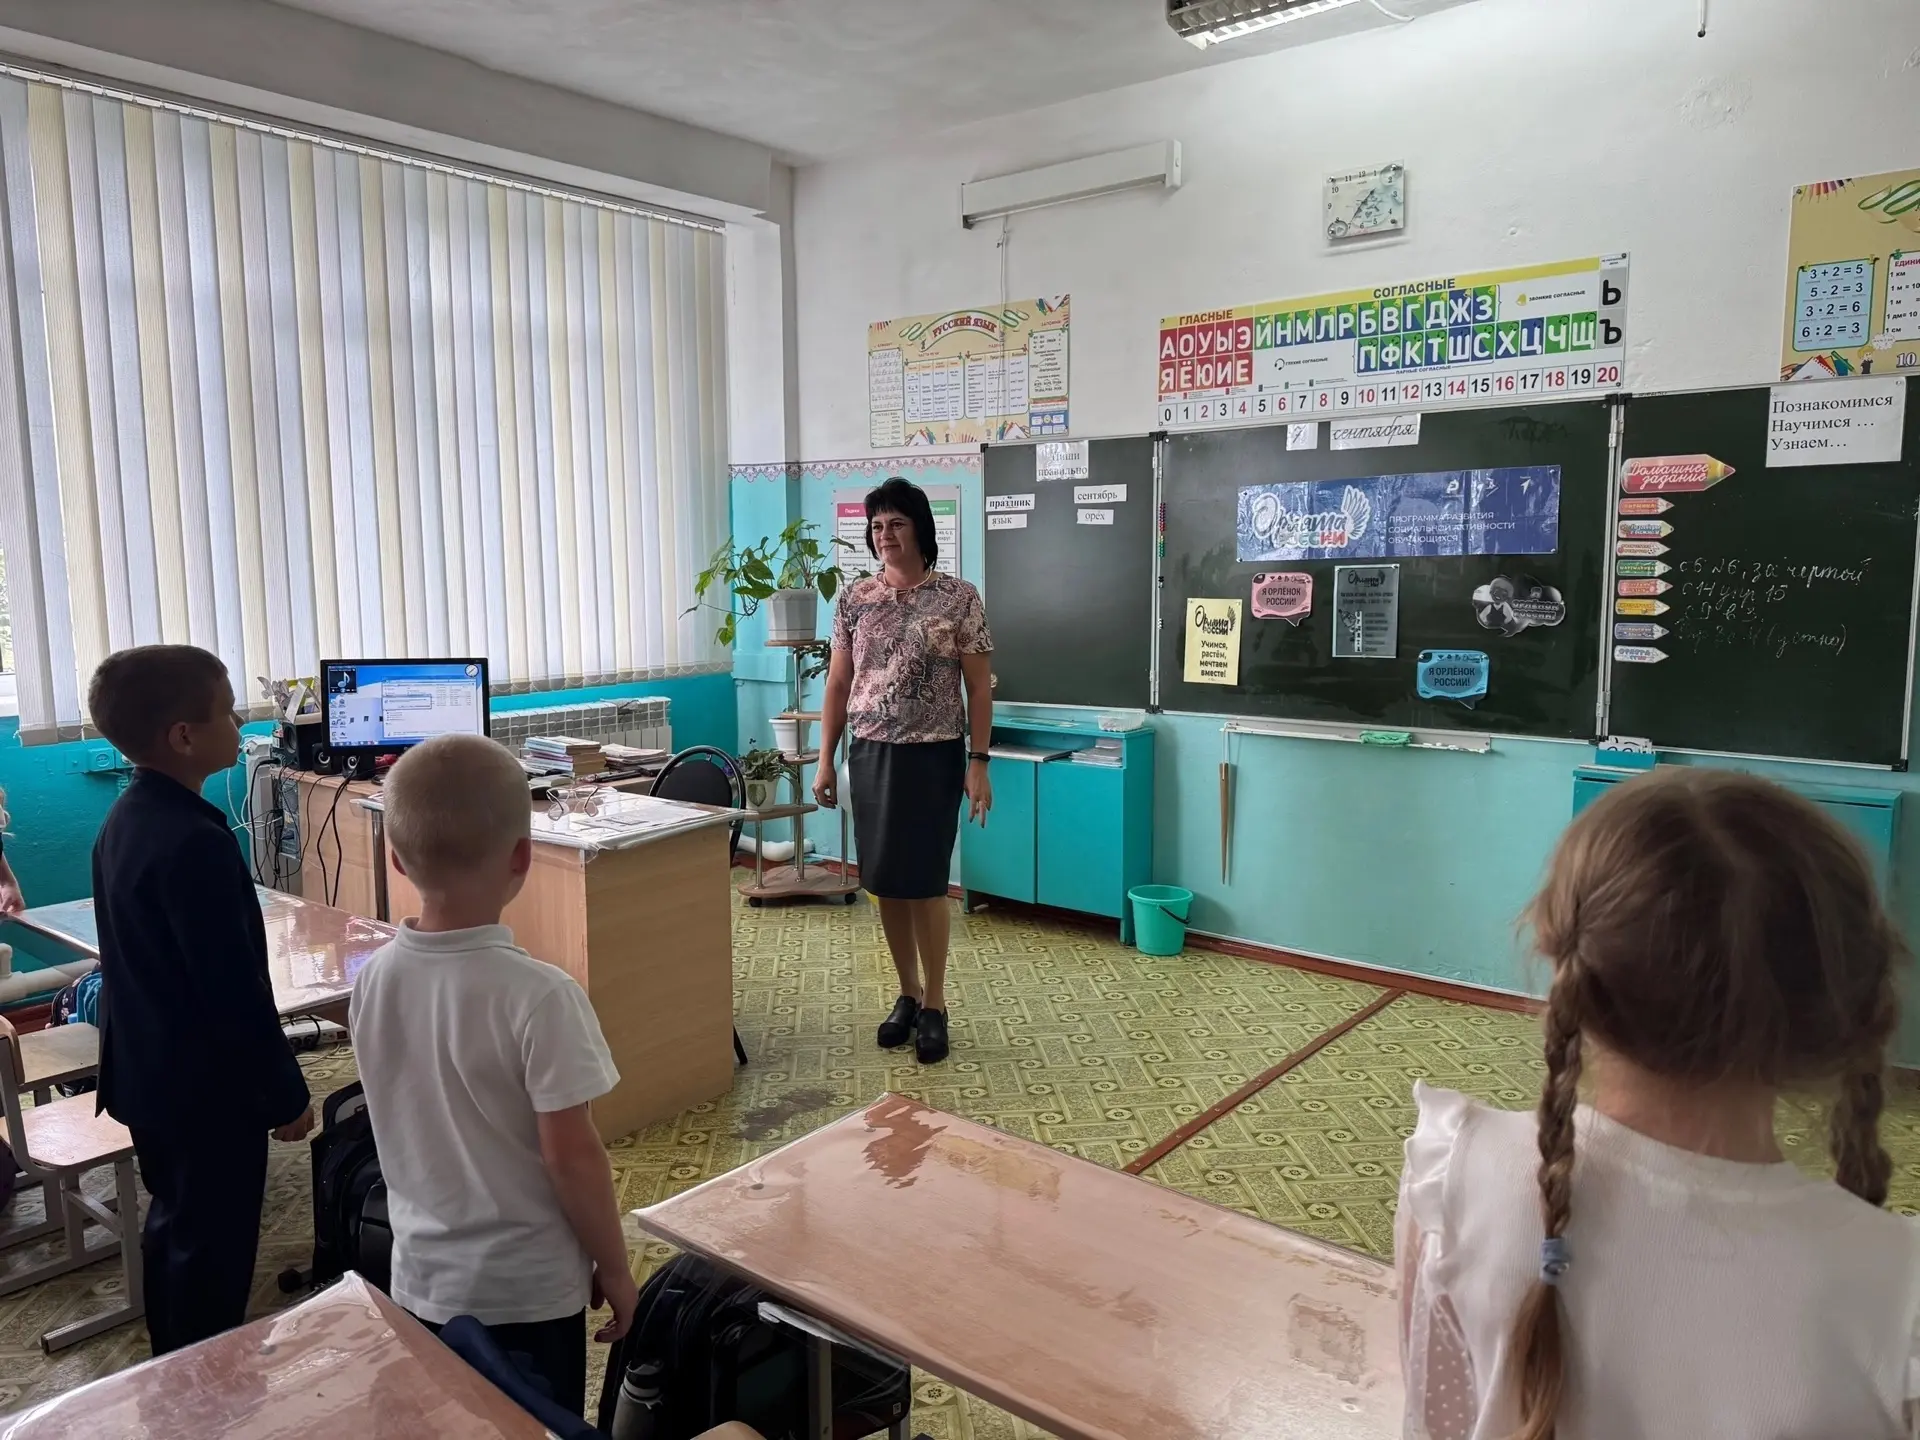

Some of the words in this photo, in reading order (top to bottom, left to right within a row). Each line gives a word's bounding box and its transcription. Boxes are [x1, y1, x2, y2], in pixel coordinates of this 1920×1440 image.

[1810, 269, 1817, 279] 3
[1832, 266, 1840, 277] 2
[1855, 263, 1863, 274] 5
[1373, 278, 1456, 299] СОГЛАСНЫЕ
[1553, 290, 1586, 298] СОГЛАСНЫЕ
[1810, 287, 1818, 297] 5
[1830, 285, 1838, 295] 2
[1855, 282, 1863, 293] 3
[1806, 306, 1813, 317] 3
[1826, 303, 1835, 315] 2
[1852, 301, 1860, 312] 6
[1179, 309, 1233, 326] ГЛАСНЫЕ
[932, 315, 972, 338] РУССКИЙ
[972, 317, 997, 333] ЯЗЫК
[1802, 326, 1810, 337] 6
[1824, 324, 1832, 336] 2
[1851, 322, 1860, 333] 3
[1164, 408, 1172, 422] 0
[1183, 407, 1189, 420] 1
[1200, 405, 1208, 419] 2
[1219, 403, 1227, 416] 3
[1239, 401, 1247, 414] 4
[1258, 399, 1266, 413] 5
[1278, 397, 1286, 411] 6
[1299, 395, 1307, 409] 7
[1319, 393, 1327, 407] 8
[1340, 391, 1349, 405] 9
[1357, 389, 1375, 404] 10
[1381, 386, 1396, 401] 11
[1402, 384, 1420, 400] 12
[1424, 382, 1442, 397] 13
[1447, 380, 1466, 396] 14
[1471, 378, 1490, 393] 15
[1495, 376, 1514, 391] 16
[1520, 374, 1539, 390] 17
[1545, 371, 1565, 387] 18
[1571, 368, 1591, 385] 19
[1597, 366, 1619, 383] 20
[1773, 396, 1893, 414] Познакомимся
[1333, 416, 1414, 444] сентября
[1771, 418, 1851, 434] Научимся
[1771, 438, 1847, 451] Узнаем...
[1038, 467, 1088, 477] правильно
[1628, 461, 1709, 476] Домашнее
[1640, 473, 1708, 490] задание
[1077, 490, 1118, 502] сентябрь
[989, 499, 1031, 509] праздник
[992, 517, 1012, 525] язык
[1085, 511, 1105, 521] орех
[1389, 513, 1443, 524] ПРОГРАММА
[1444, 512, 1494, 521] РАЗВИТИЯ
[1388, 524, 1450, 534] СОЦИАЛЬНОЙ
[1453, 522, 1515, 532] АКТИВНОСТИ
[1388, 535, 1458, 544] ОБУЧАЮЩИХСЯ
[1268, 586, 1301, 596] ОРЛЁНОК
[1266, 597, 1296, 606] РОССИИ!
[1201, 640, 1228, 650] Учимся,
[1201, 650, 1227, 660] растём,
[1200, 660, 1228, 669] мечтаем
[1201, 669, 1226, 678] вместе!
[1428, 667, 1434, 676] Я
[1436, 666, 1475, 676] ОРЛЁНОК
[1434, 677, 1470, 686] РОССИИ!
